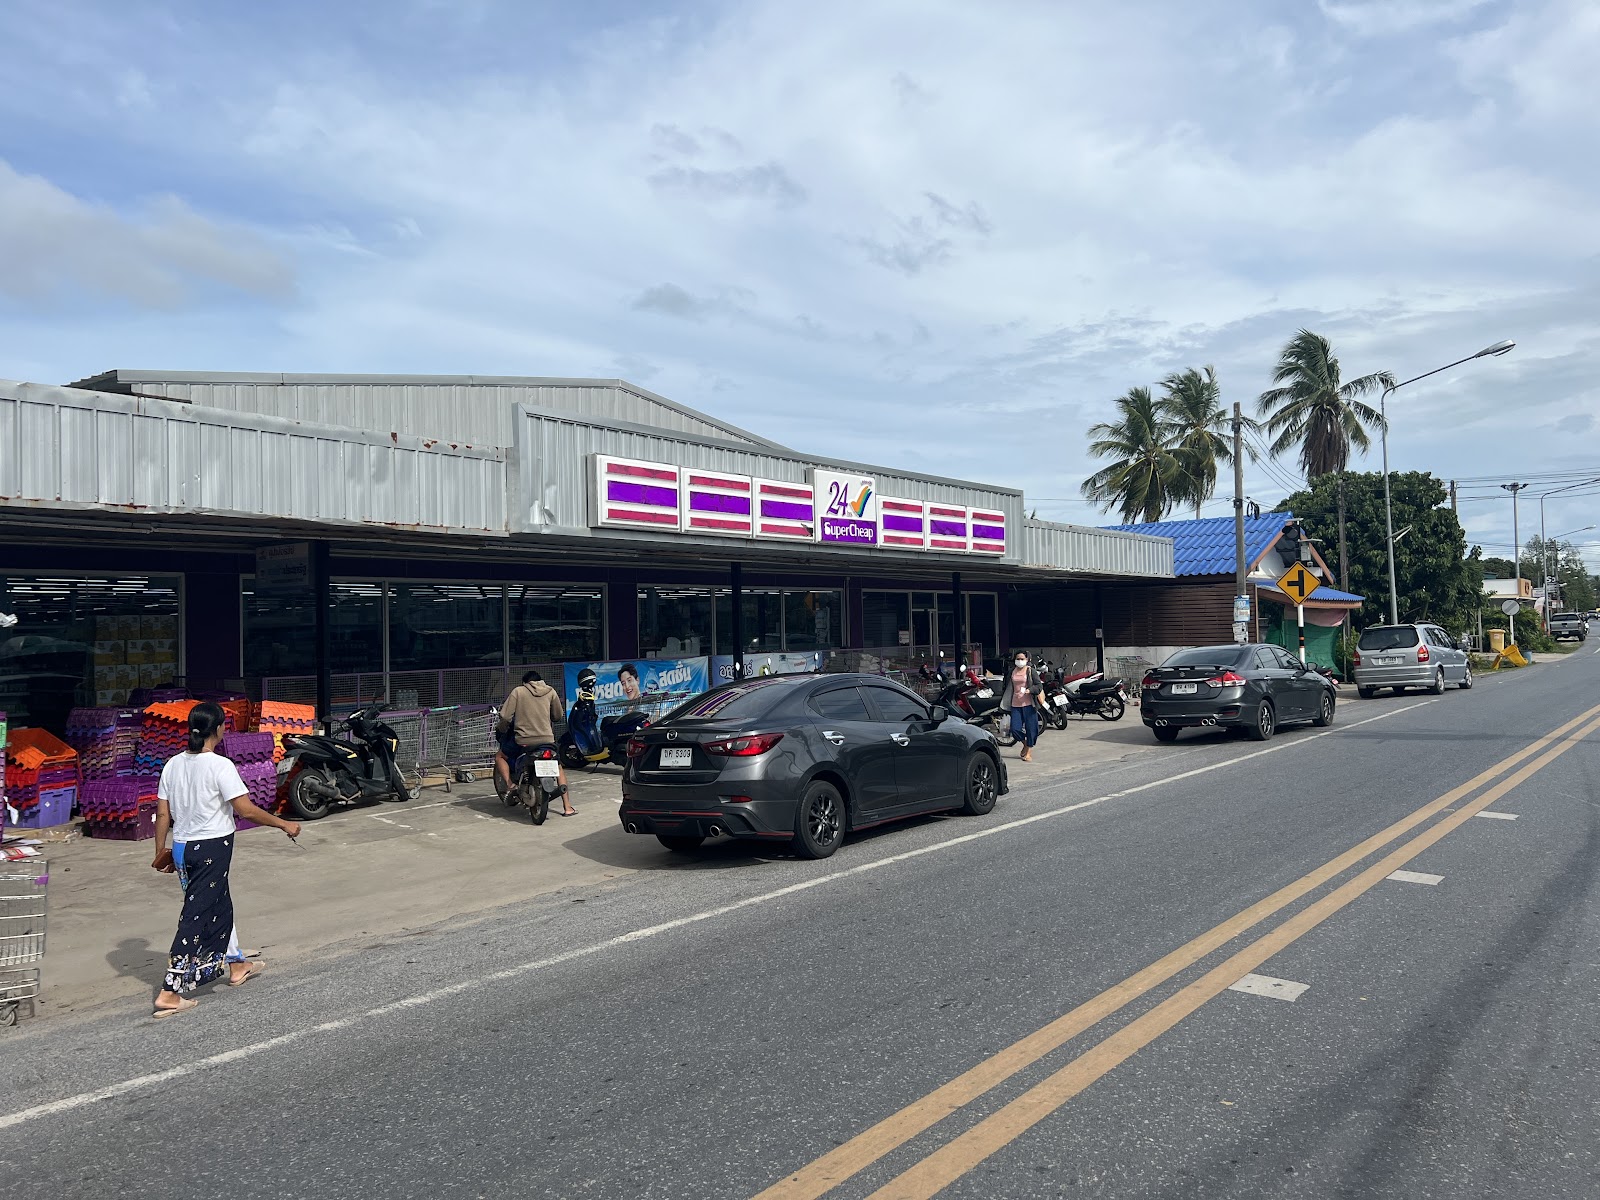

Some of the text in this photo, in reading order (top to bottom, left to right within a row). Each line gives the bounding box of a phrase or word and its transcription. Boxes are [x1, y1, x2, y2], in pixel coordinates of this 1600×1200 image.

[826, 481, 848, 516] 24
[824, 522, 873, 541] SuperCheap
[659, 661, 691, 687] สดชื่น
